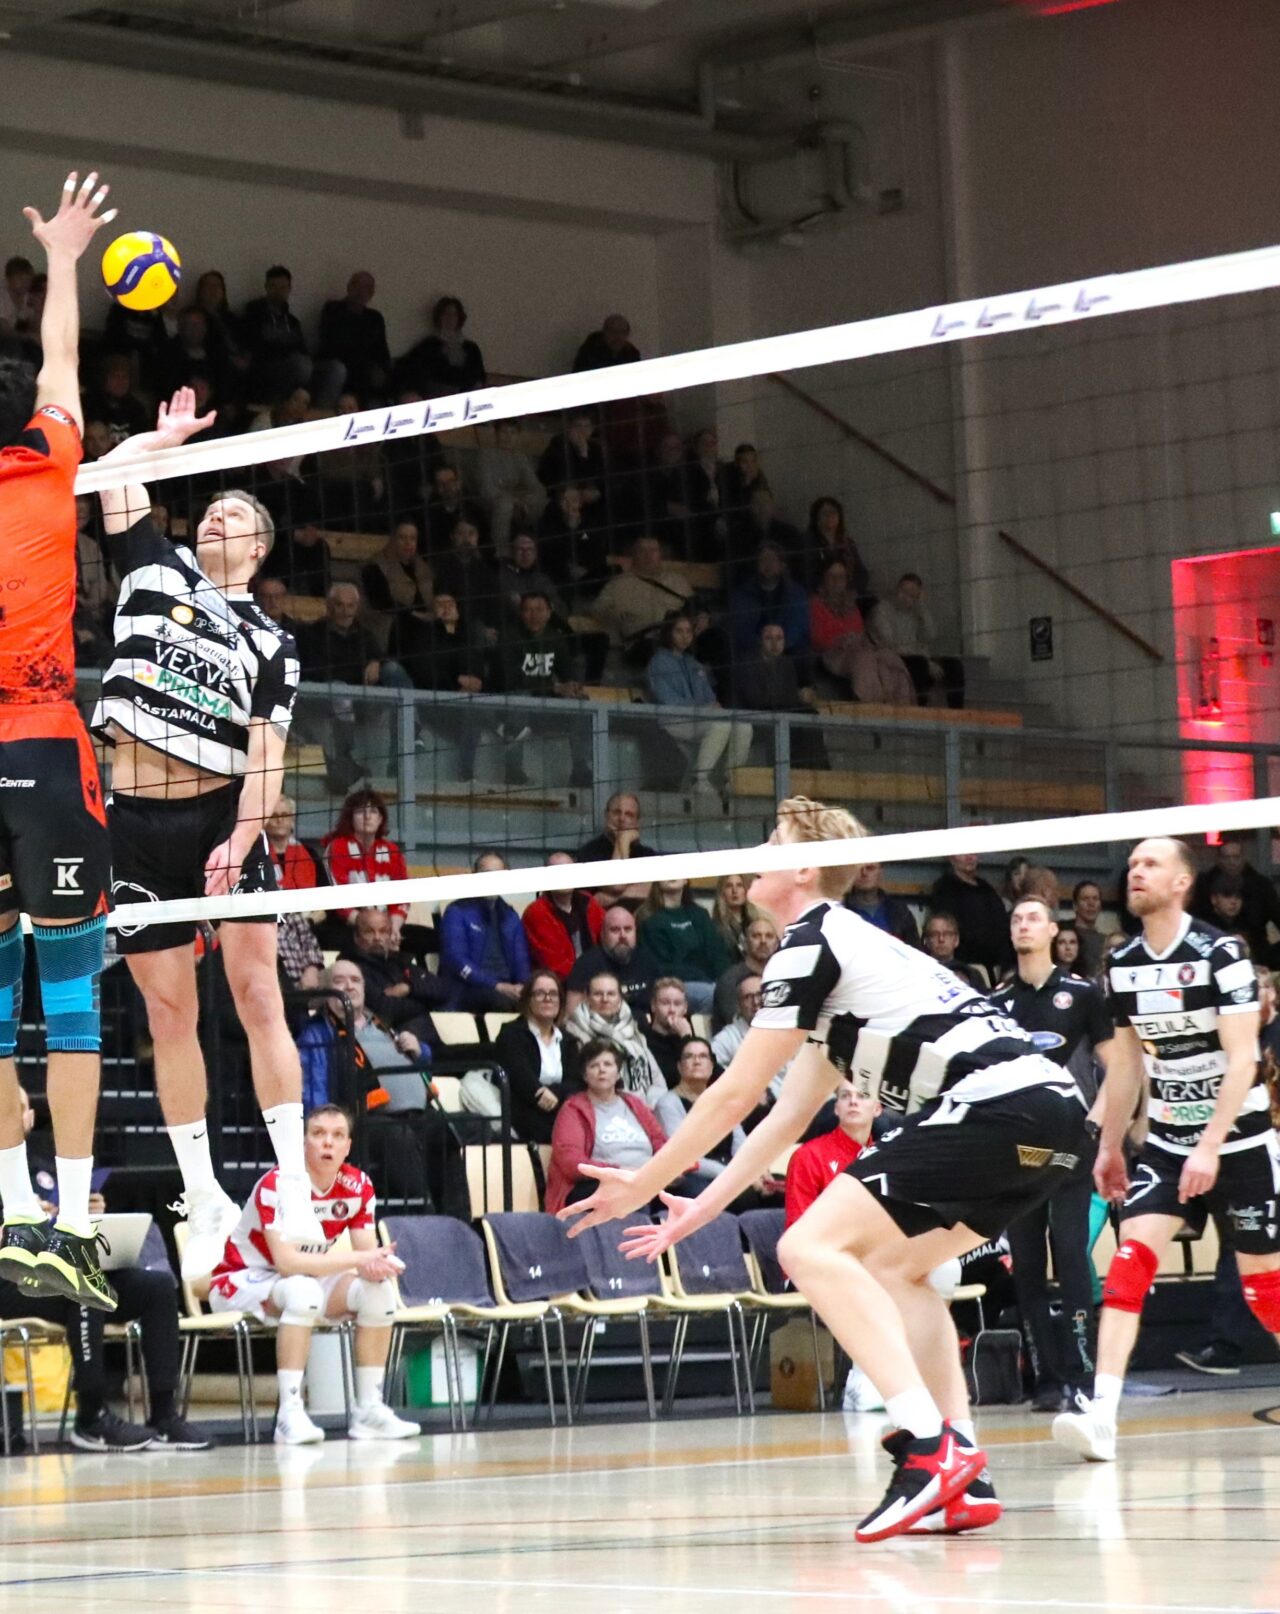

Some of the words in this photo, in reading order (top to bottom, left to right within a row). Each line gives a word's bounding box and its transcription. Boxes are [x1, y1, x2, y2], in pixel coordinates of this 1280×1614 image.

[6, 577, 28, 592] OY
[156, 668, 232, 719] PRISMA
[133, 695, 217, 735] SASTAMALA
[1154, 968, 1163, 985] 7
[528, 1264, 542, 1279] 14
[609, 1278, 623, 1290] 11
